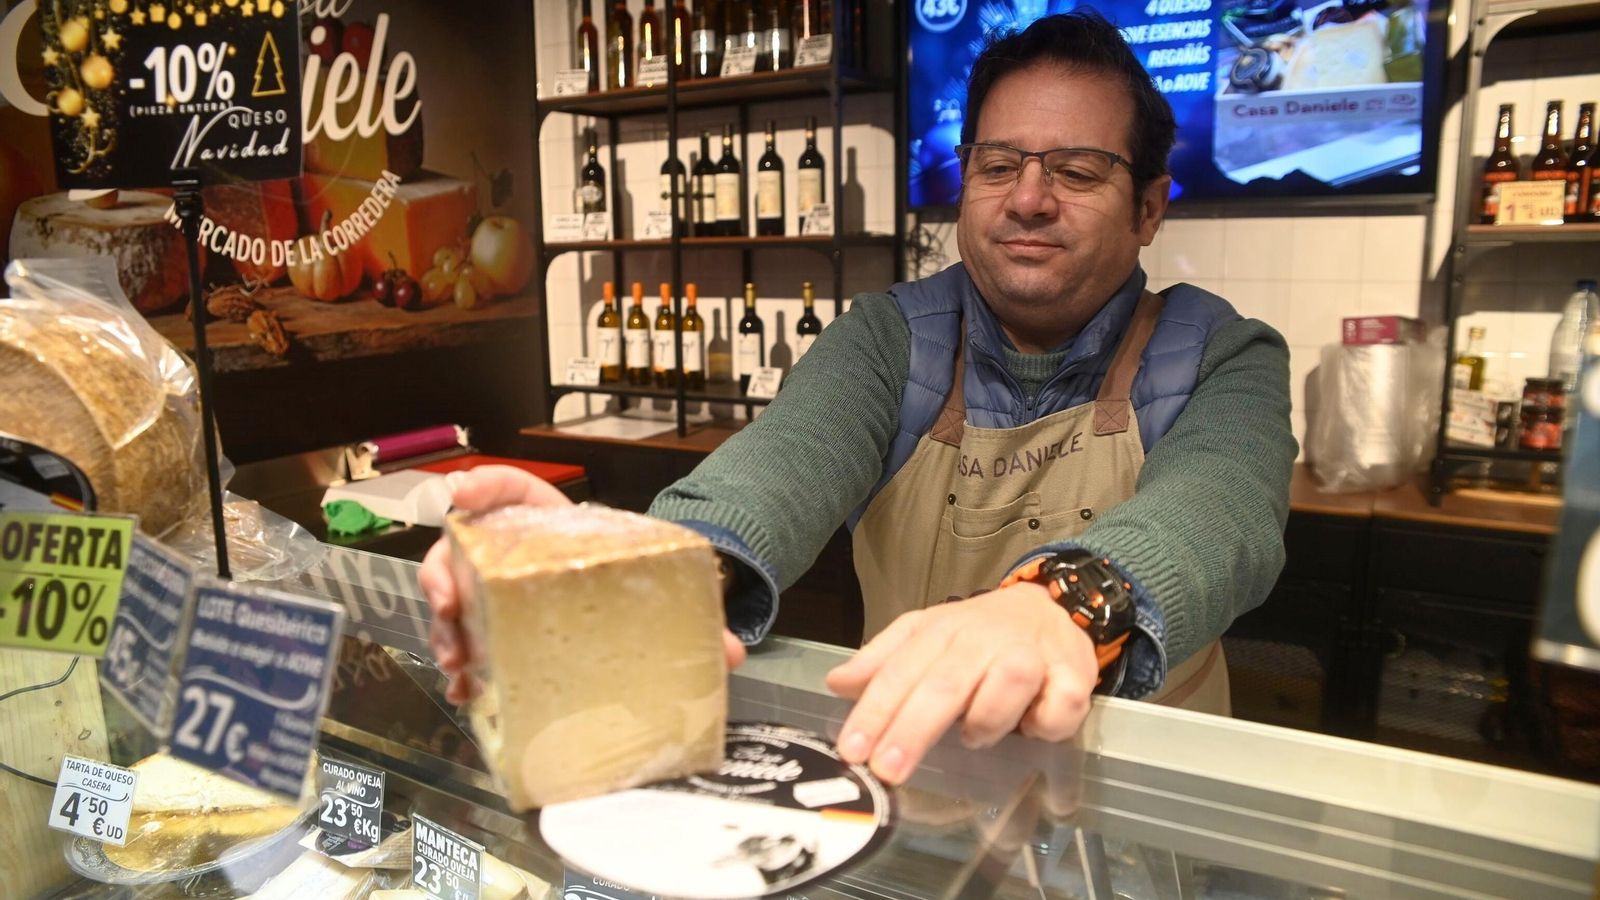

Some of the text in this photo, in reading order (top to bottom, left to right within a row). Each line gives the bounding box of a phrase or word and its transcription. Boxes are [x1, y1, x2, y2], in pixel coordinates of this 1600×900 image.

[129, 41, 235, 103] -10%
[301, 13, 422, 144] iele
[228, 109, 287, 129] QUESO
[1233, 104, 1279, 118] Casa
[1285, 98, 1359, 115] Daniele
[170, 106, 290, 170] Navidad
[163, 169, 402, 267] MRCADO DE LA CORREDERA
[957, 432, 1084, 479] SA DANIELE
[2, 521, 122, 570] OFERTA
[175, 684, 250, 764] 27€
[66, 758, 134, 787] TARTA DE QUESO
[81, 777, 112, 793] CASERA
[322, 762, 382, 789] CURADO OVEJA
[335, 780, 366, 797] AL VINO
[416, 822, 478, 872] MANTECA
[417, 842, 476, 882] CURADO OVEJA
